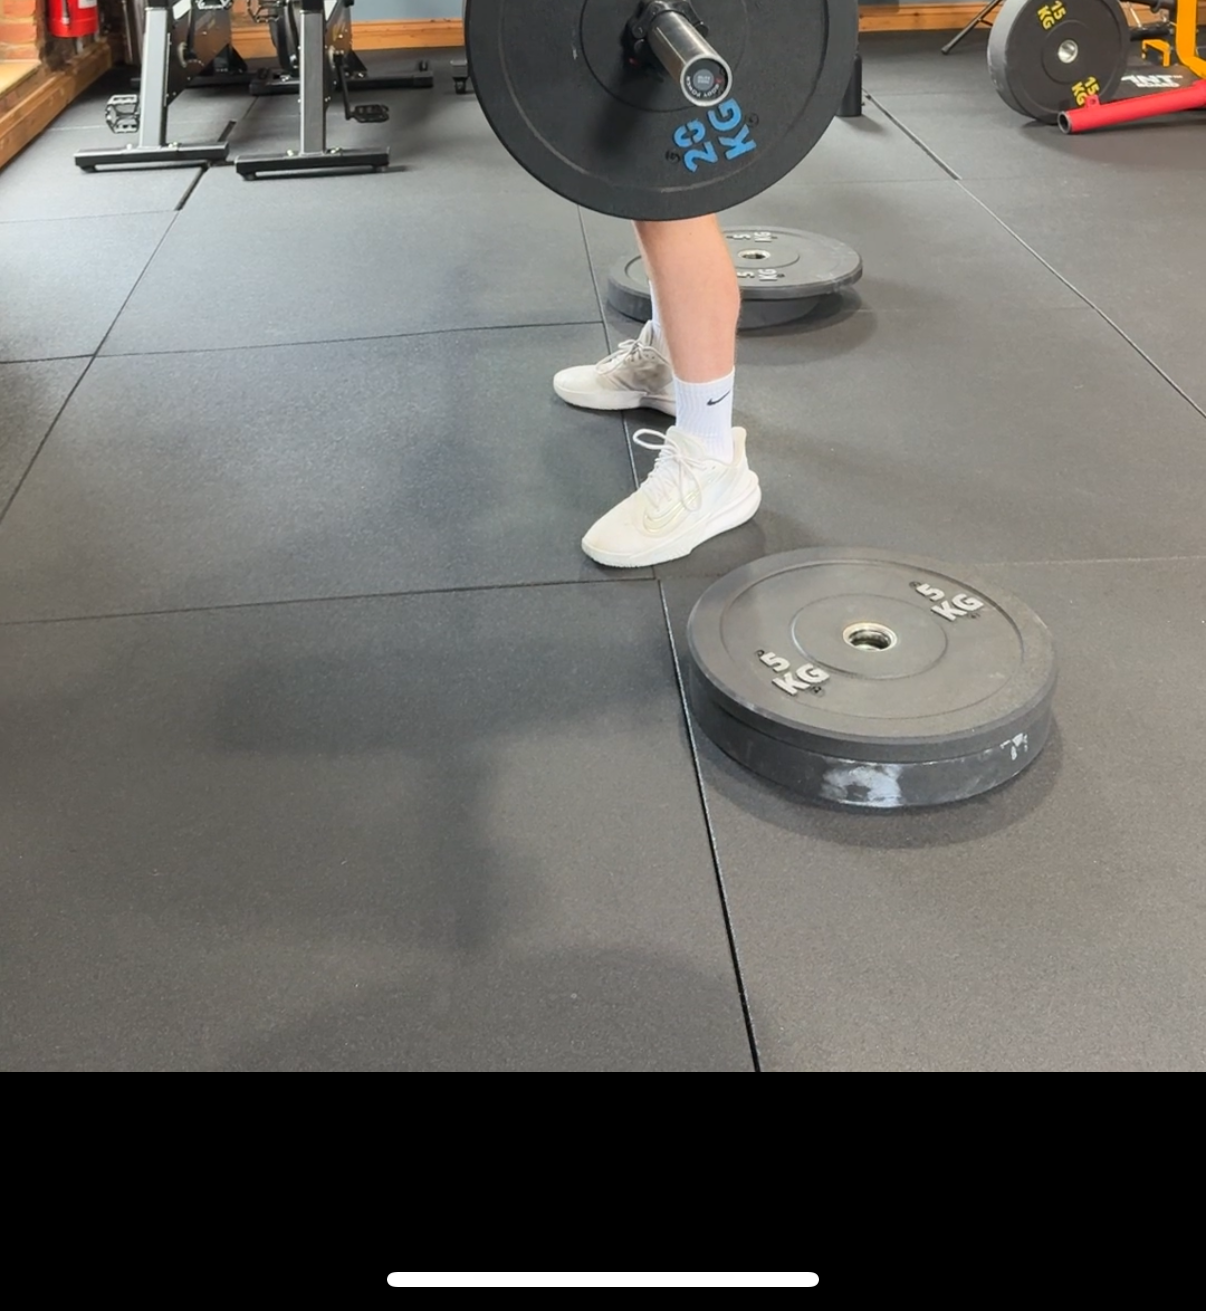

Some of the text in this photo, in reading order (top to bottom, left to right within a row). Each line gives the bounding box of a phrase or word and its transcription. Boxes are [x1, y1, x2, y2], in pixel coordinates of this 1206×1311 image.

[1038, 5, 1055, 30] KG
[1051, 0, 1066, 20] 15
[1072, 81, 1088, 106] KG
[1085, 77, 1100, 96] 15
[708, 97, 757, 160] KG
[674, 118, 718, 172] 20
[916, 583, 945, 601] 5
[931, 593, 984, 622] KG
[760, 652, 790, 672] 5
[772, 663, 831, 696] KG
